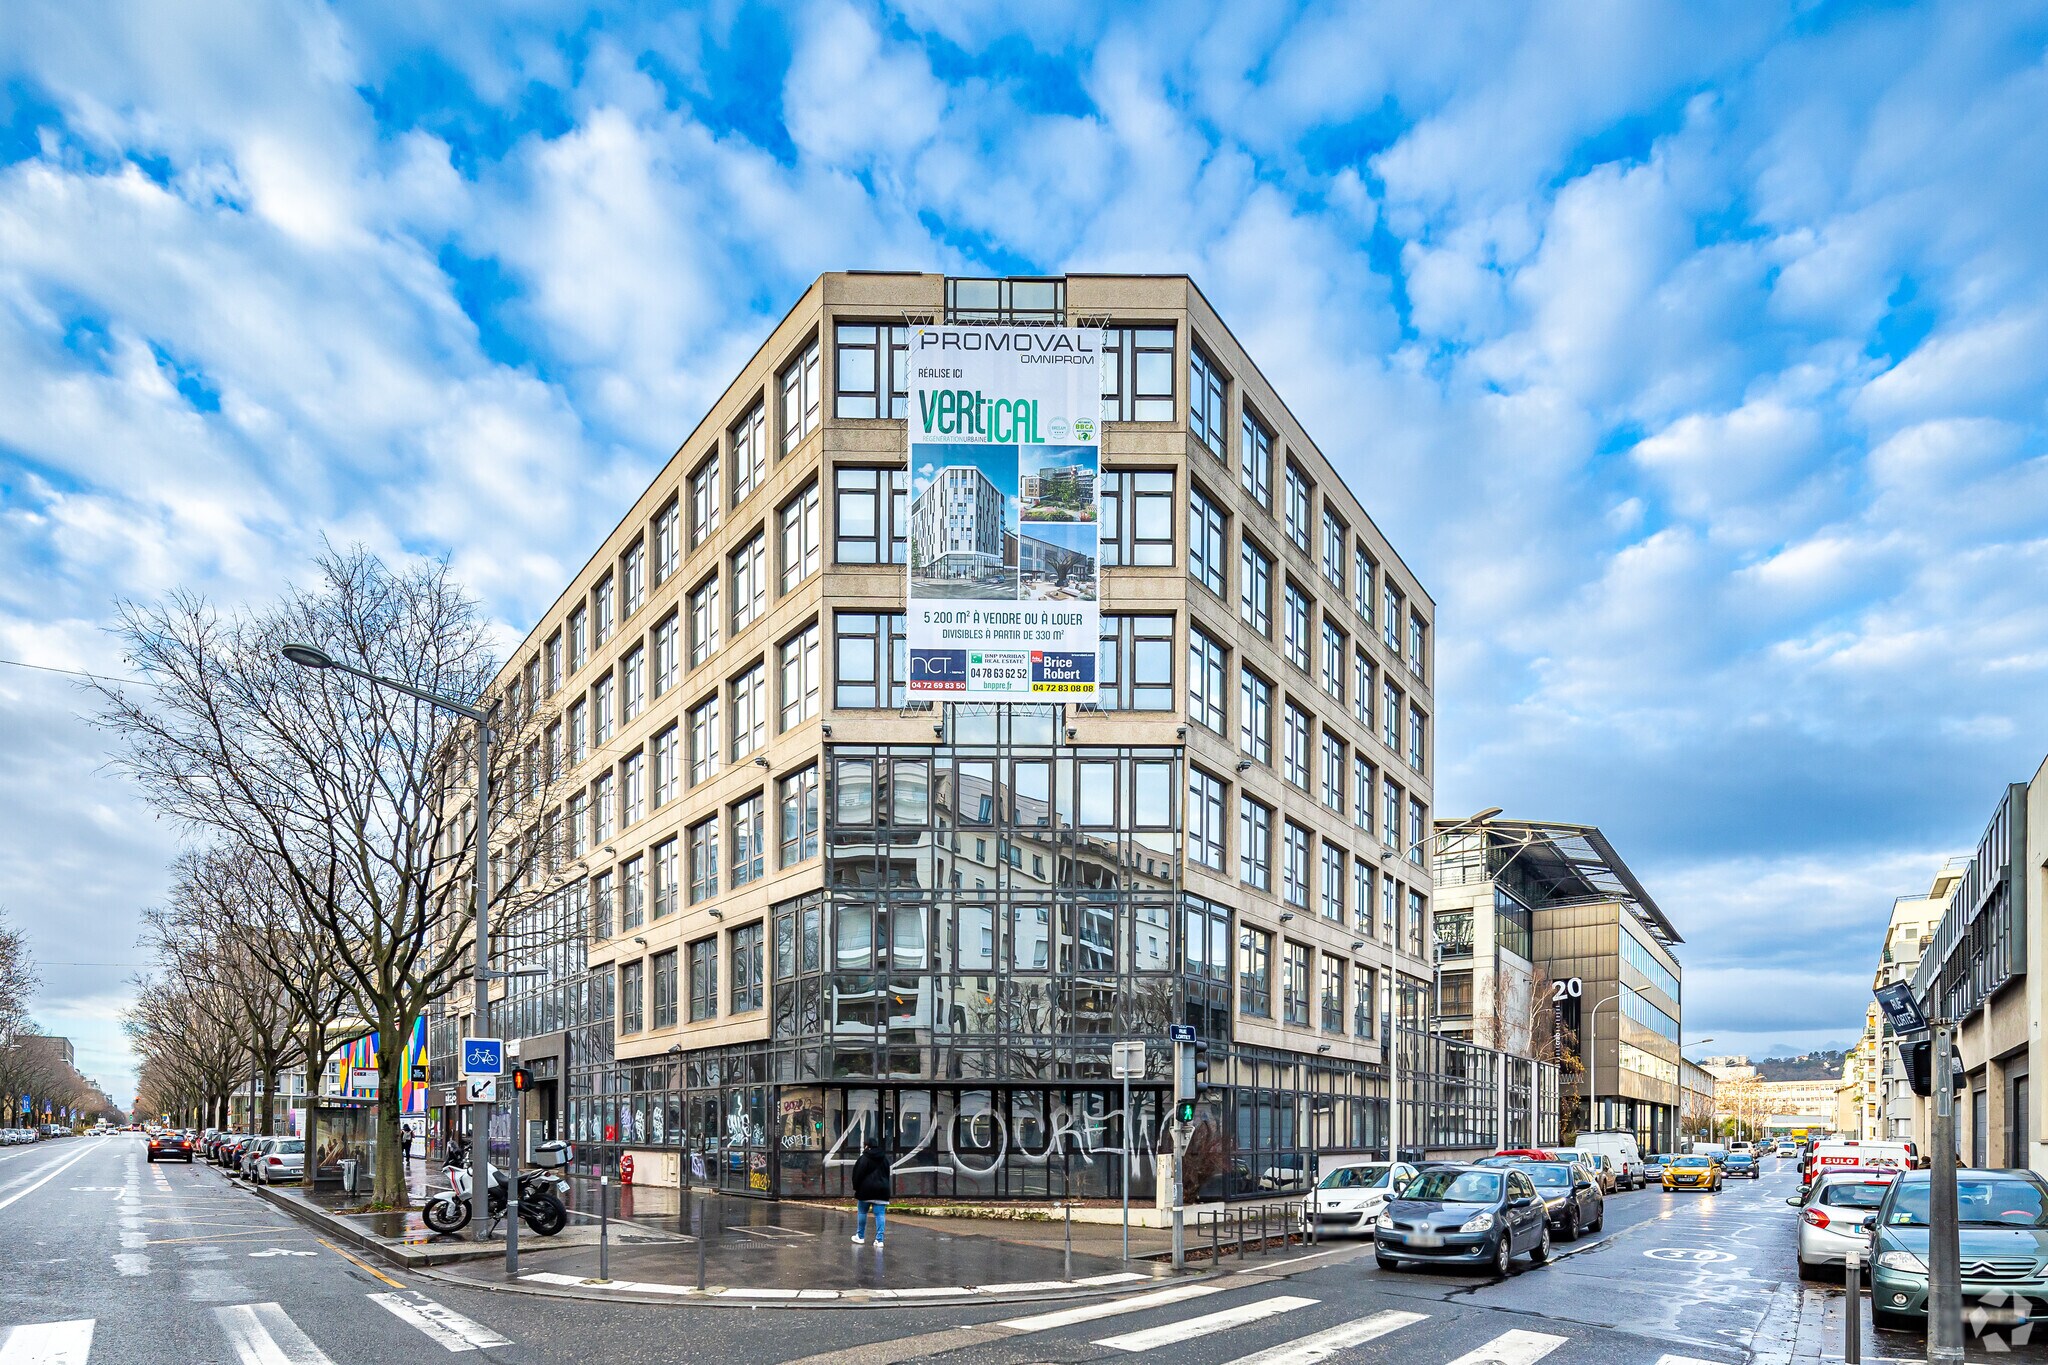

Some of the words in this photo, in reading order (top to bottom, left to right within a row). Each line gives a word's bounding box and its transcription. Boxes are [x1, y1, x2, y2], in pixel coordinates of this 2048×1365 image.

[921, 333, 1093, 352] PROMOVAL
[1021, 355, 1094, 365] OMNIPROM
[919, 368, 950, 378] RÉALISE
[953, 369, 963, 379] ICI
[924, 612, 930, 624] 5
[934, 612, 952, 624] 200
[974, 610, 980, 624] À
[983, 613, 1021, 625] VENDRE
[1025, 613, 1038, 625] OU
[1041, 610, 1048, 625] À
[1052, 614, 1083, 626] LOUER
[942, 629, 983, 639] DIVISIBLES
[986, 628, 991, 640] À
[994, 630, 1021, 640] PARTIR
[1024, 630, 1033, 640] DE
[1036, 630, 1050, 640] 330
[1044, 656, 1072, 668] Brice
[971, 668, 981, 678] 04
[983, 668, 992, 678] 78
[994, 669, 1004, 678] 63
[1006, 669, 1015, 679] 62
[1017, 669, 1027, 679] 52
[1044, 668, 1080, 679] Robert
[984, 681, 1012, 691] bnppre.fr
[1552, 978, 1582, 1002] 20
[1890, 998, 1904, 1010] RUE
[1670, 1251, 1717, 1260] 30
